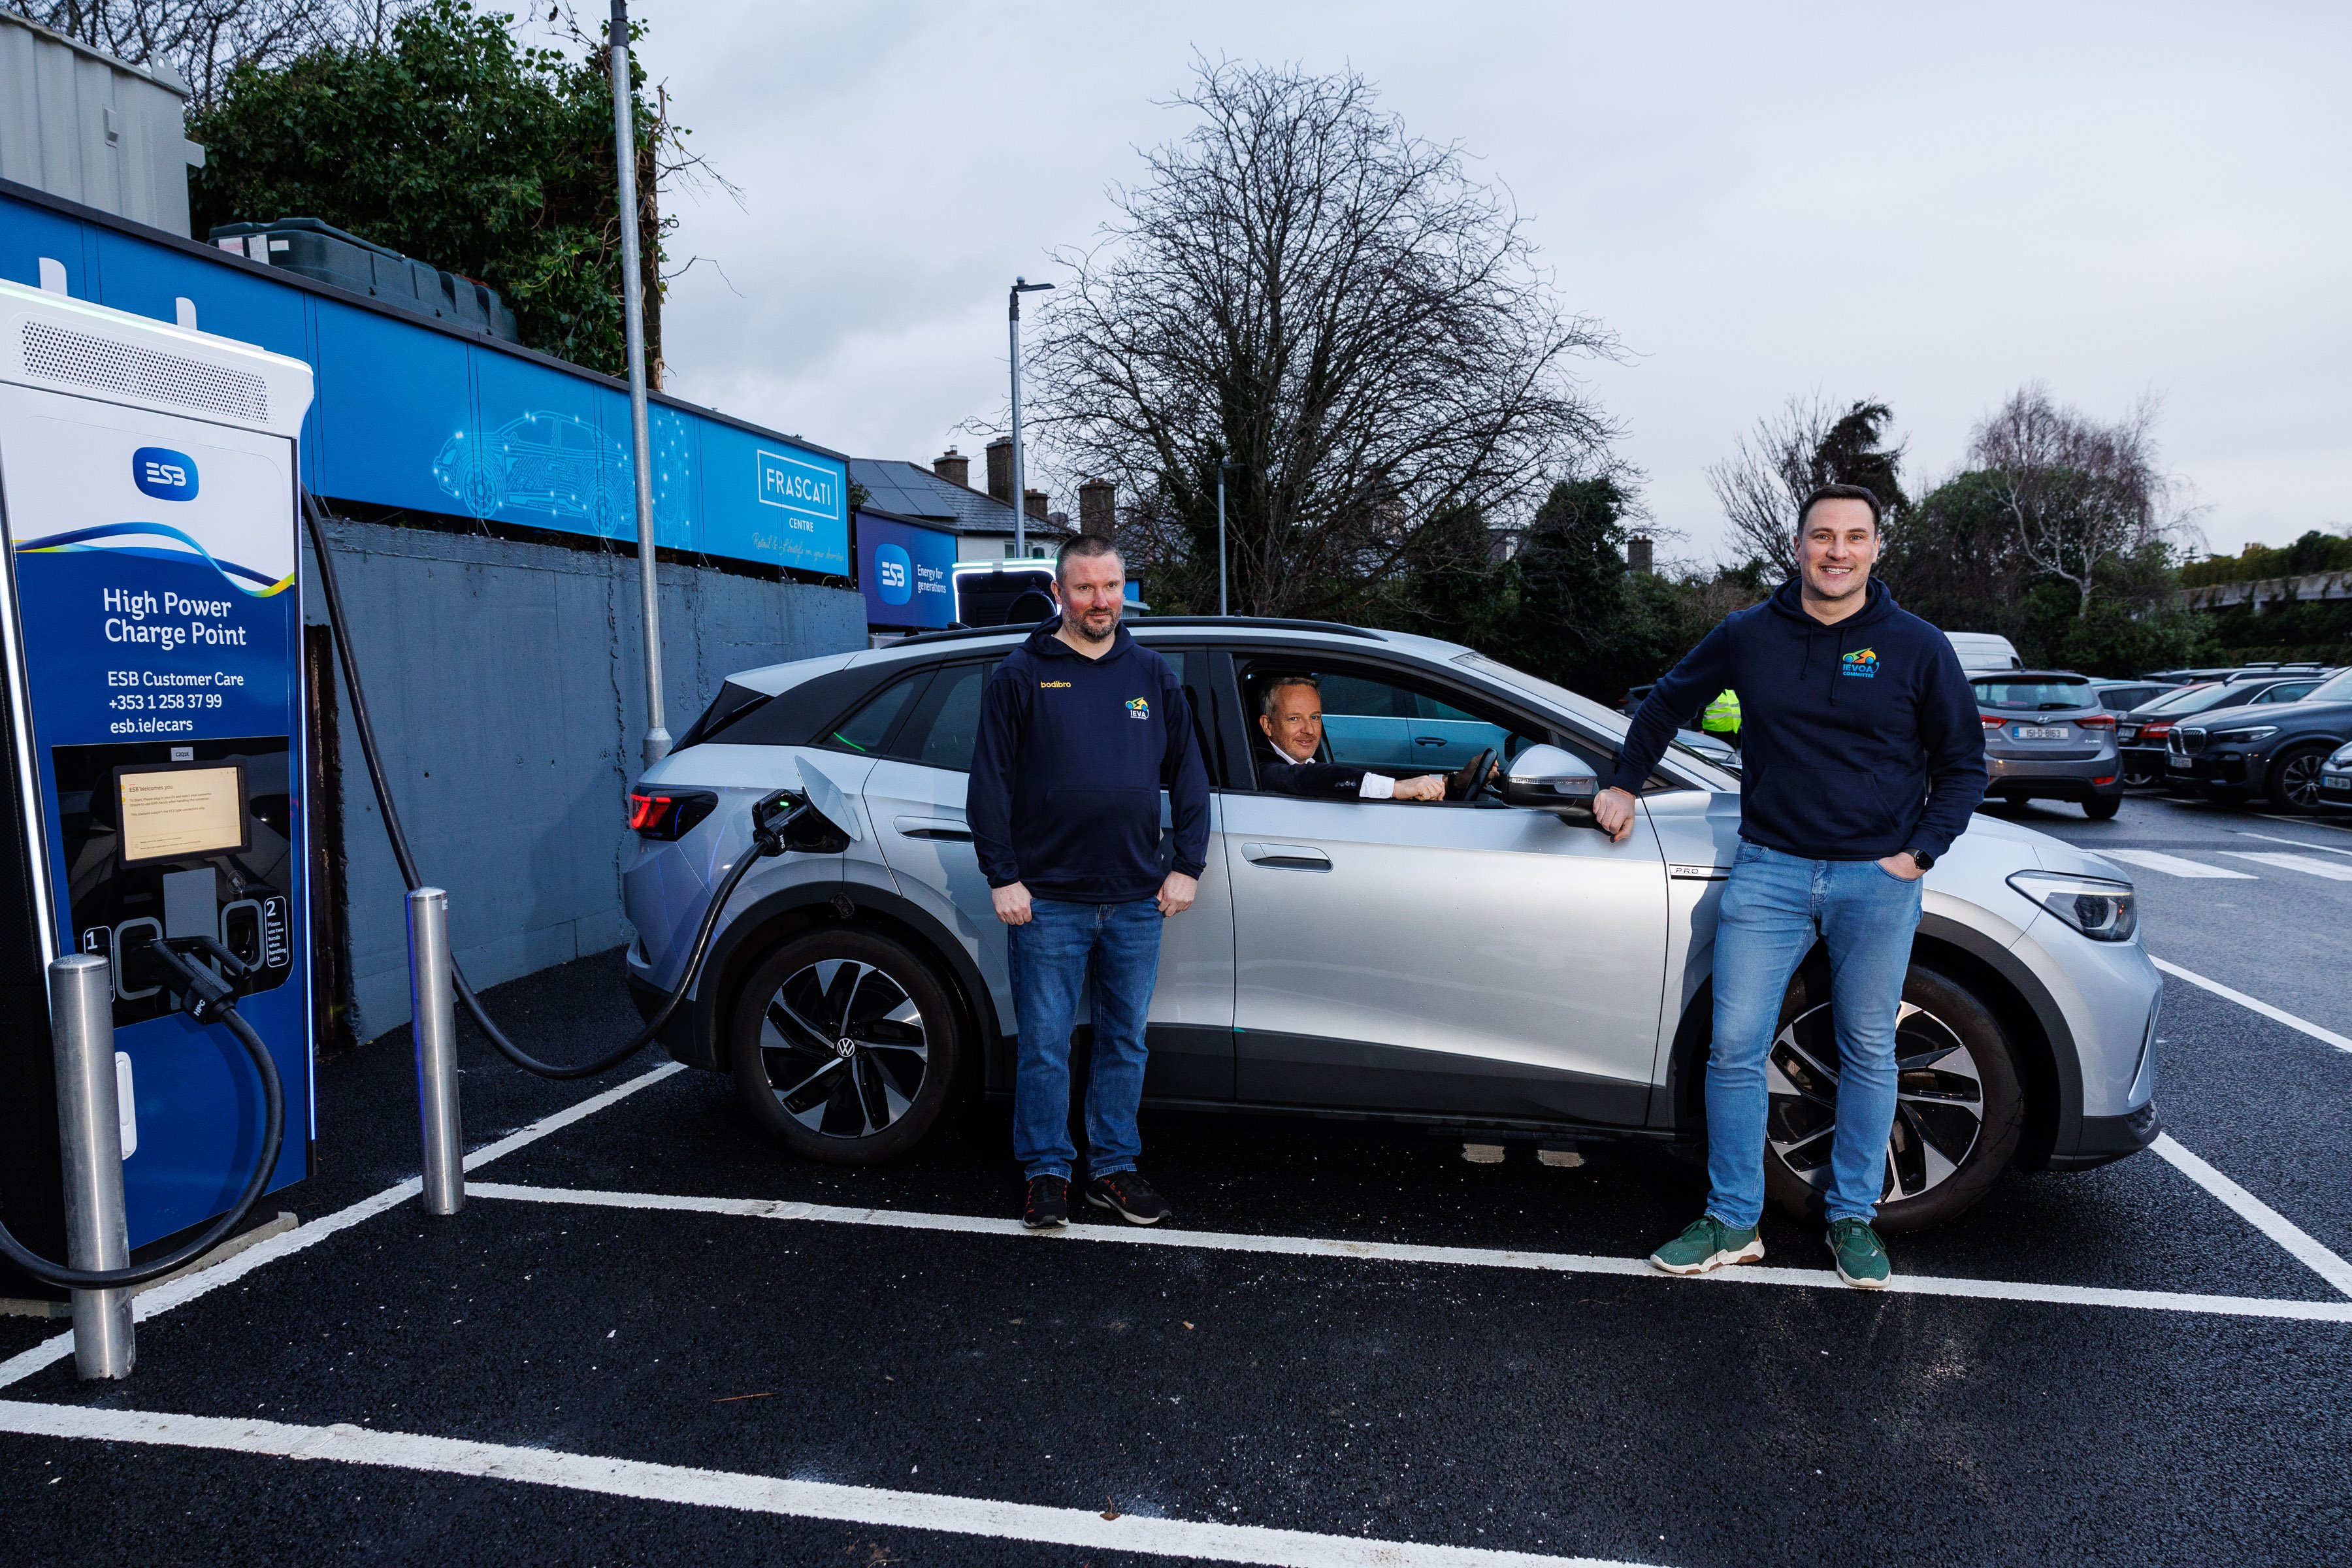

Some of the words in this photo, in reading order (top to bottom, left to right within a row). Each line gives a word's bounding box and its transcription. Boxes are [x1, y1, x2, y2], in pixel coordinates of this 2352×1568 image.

[146, 461, 187, 487] ESB
[766, 468, 831, 506] FRASCATI
[789, 517, 814, 532] CENTRE
[882, 561, 905, 587] ESB
[917, 564, 935, 581] Energy
[917, 581, 947, 593] generations
[103, 588, 158, 620] High
[165, 592, 231, 617] Power
[105, 618, 186, 651] Charge
[192, 622, 246, 645] Point
[1842, 663, 1873, 674] IEVOA
[108, 671, 139, 686] ESB
[143, 671, 212, 686] Customer
[214, 672, 244, 686] Care
[109, 694, 144, 710] +353
[148, 695, 156, 709] 1
[159, 694, 184, 709] 258
[1130, 710, 1146, 718] IEVA
[110, 717, 193, 733] esb.ie/ecars
[267, 900, 276, 917] 2
[86, 931, 98, 950] 1
[193, 999, 206, 1017] HPC
